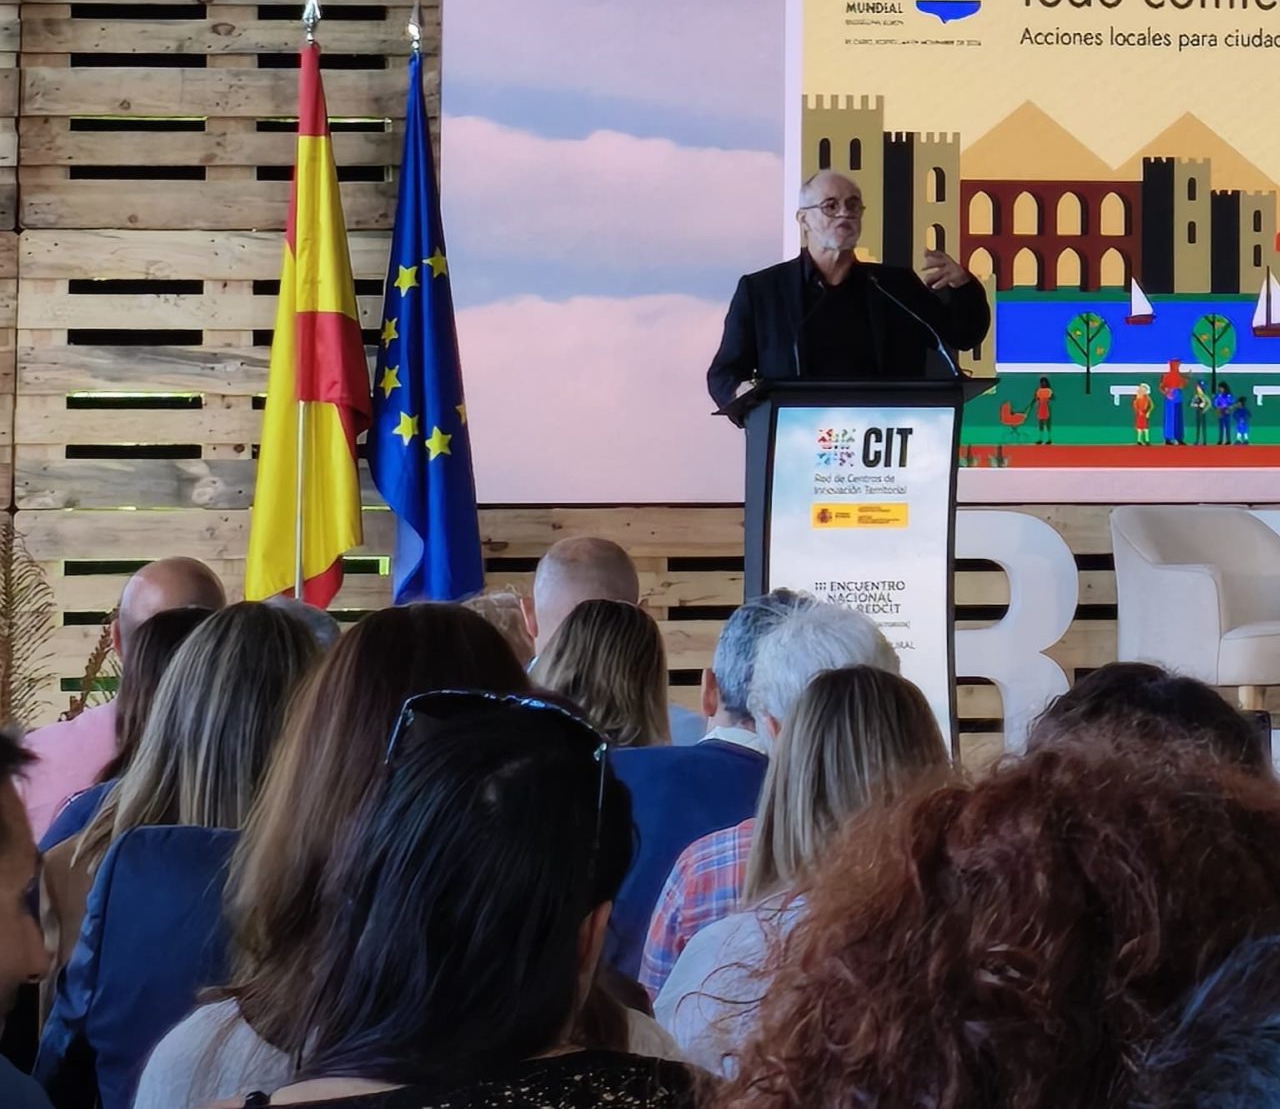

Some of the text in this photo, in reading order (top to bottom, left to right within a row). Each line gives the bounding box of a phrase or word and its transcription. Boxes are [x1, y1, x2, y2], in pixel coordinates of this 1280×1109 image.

[845, 1, 904, 14] MUNDIAL
[1019, 26, 1104, 46] Acciones
[1110, 25, 1172, 47] locales
[1178, 33, 1218, 53] para
[862, 427, 913, 468] CIT
[830, 580, 906, 592] ENCUENTRO
[827, 592, 893, 604] NACIONAL
